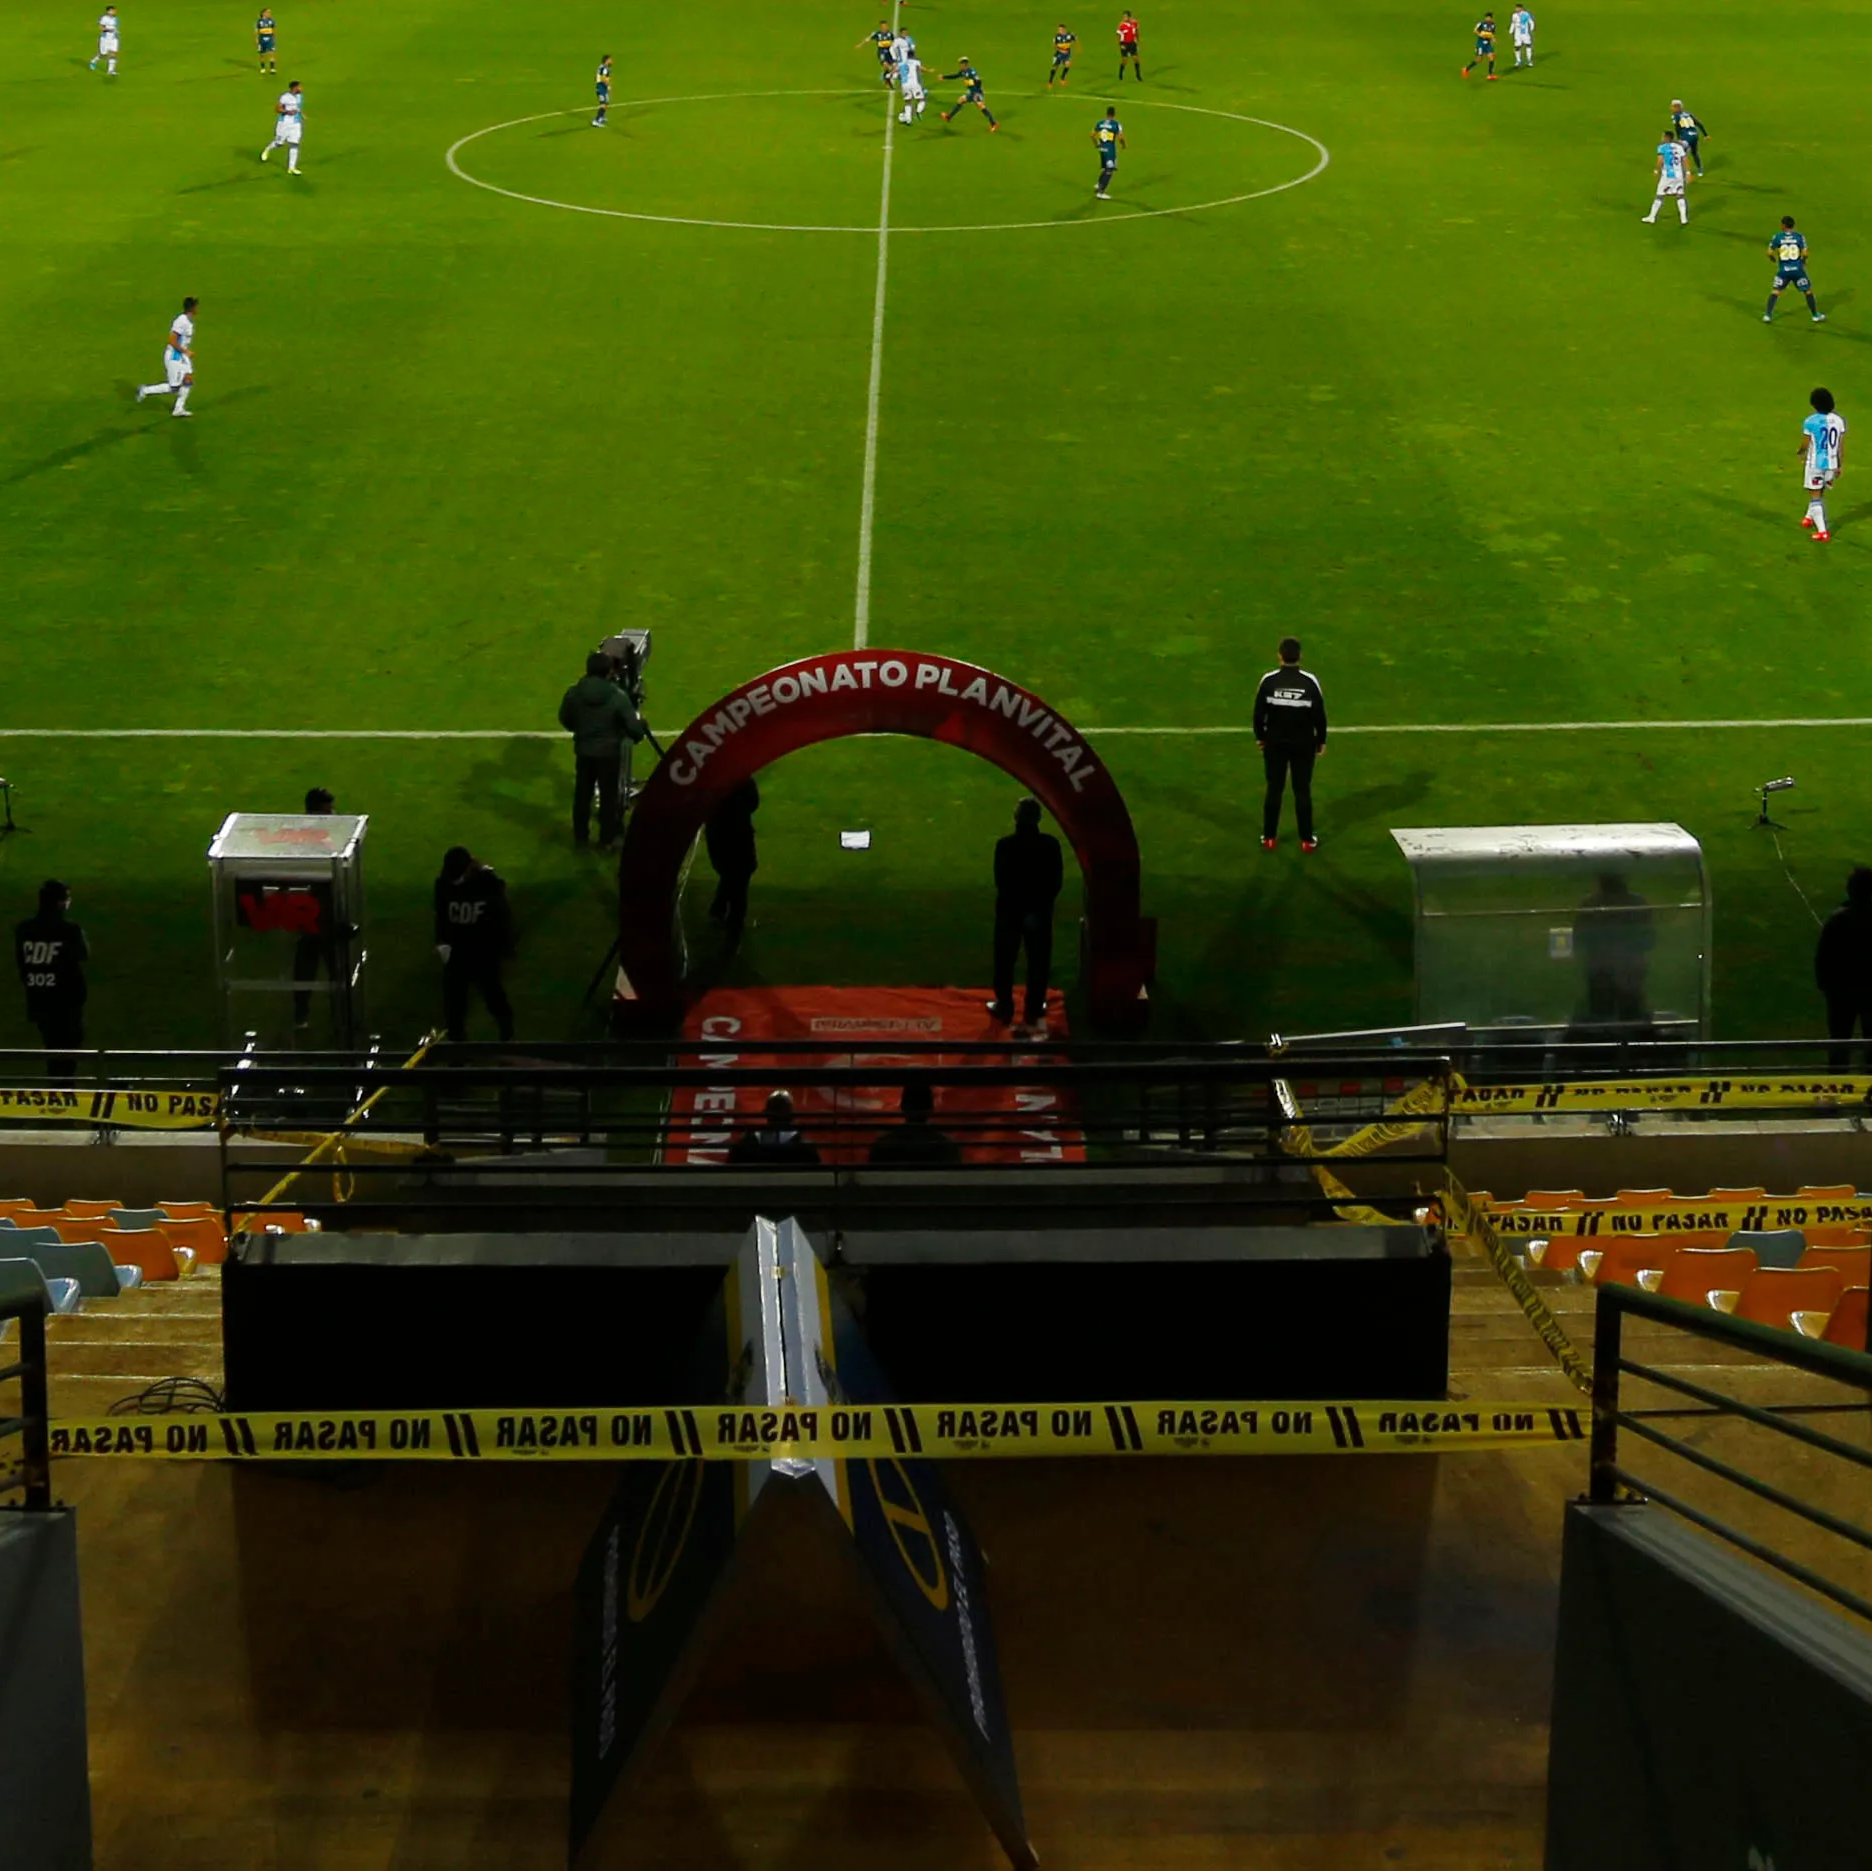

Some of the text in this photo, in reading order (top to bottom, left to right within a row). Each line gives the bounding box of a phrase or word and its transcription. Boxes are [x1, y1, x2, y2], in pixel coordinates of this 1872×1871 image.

[1820, 426, 1838, 449] 20
[669, 660, 1098, 793] CAMPEONATO PLANVITAL
[449, 901, 487, 924] CDF
[22, 941, 63, 964] CDF
[27, 972, 57, 987] 302
[126, 1093, 158, 1112] NO
[1612, 1214, 1642, 1231] NO
[1777, 1207, 1808, 1226] NO
